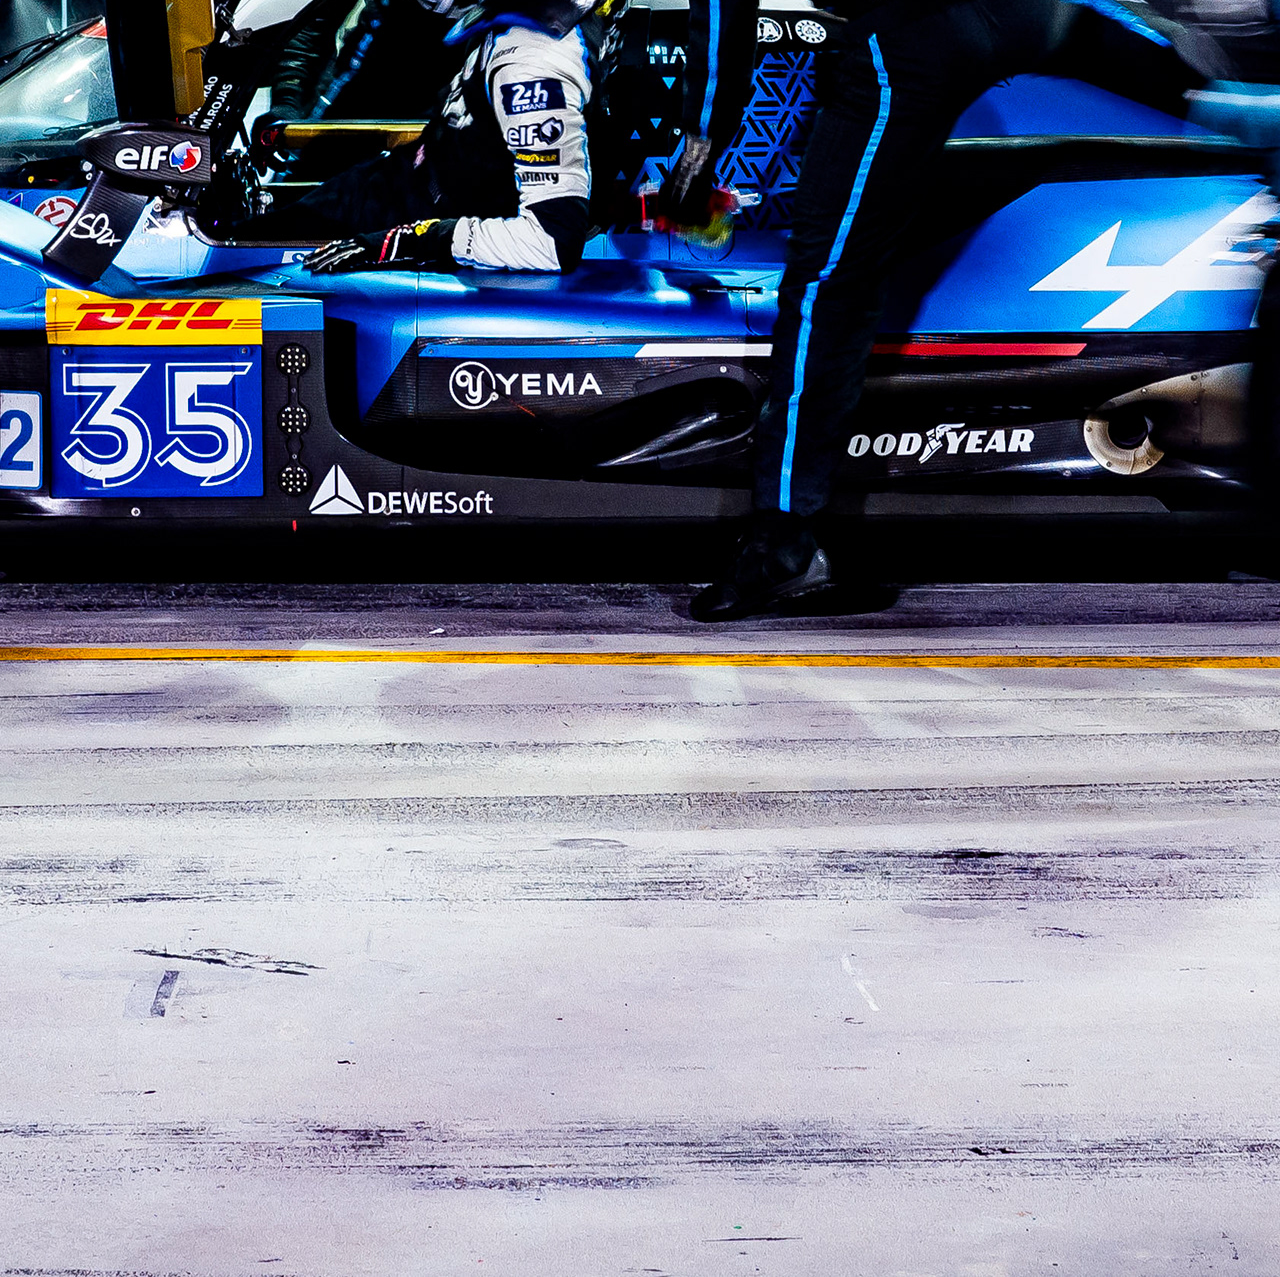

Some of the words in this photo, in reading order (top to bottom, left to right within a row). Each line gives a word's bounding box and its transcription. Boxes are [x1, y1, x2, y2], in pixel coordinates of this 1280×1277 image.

[511, 82, 550, 107] 24h
[507, 124, 540, 146] elf
[114, 144, 169, 171] elf
[74, 301, 234, 331] DHL
[496, 372, 603, 397] YEMA
[61, 362, 253, 488] 35
[848, 423, 1035, 464] OODYEAR
[367, 491, 494, 515] DEWESoft
